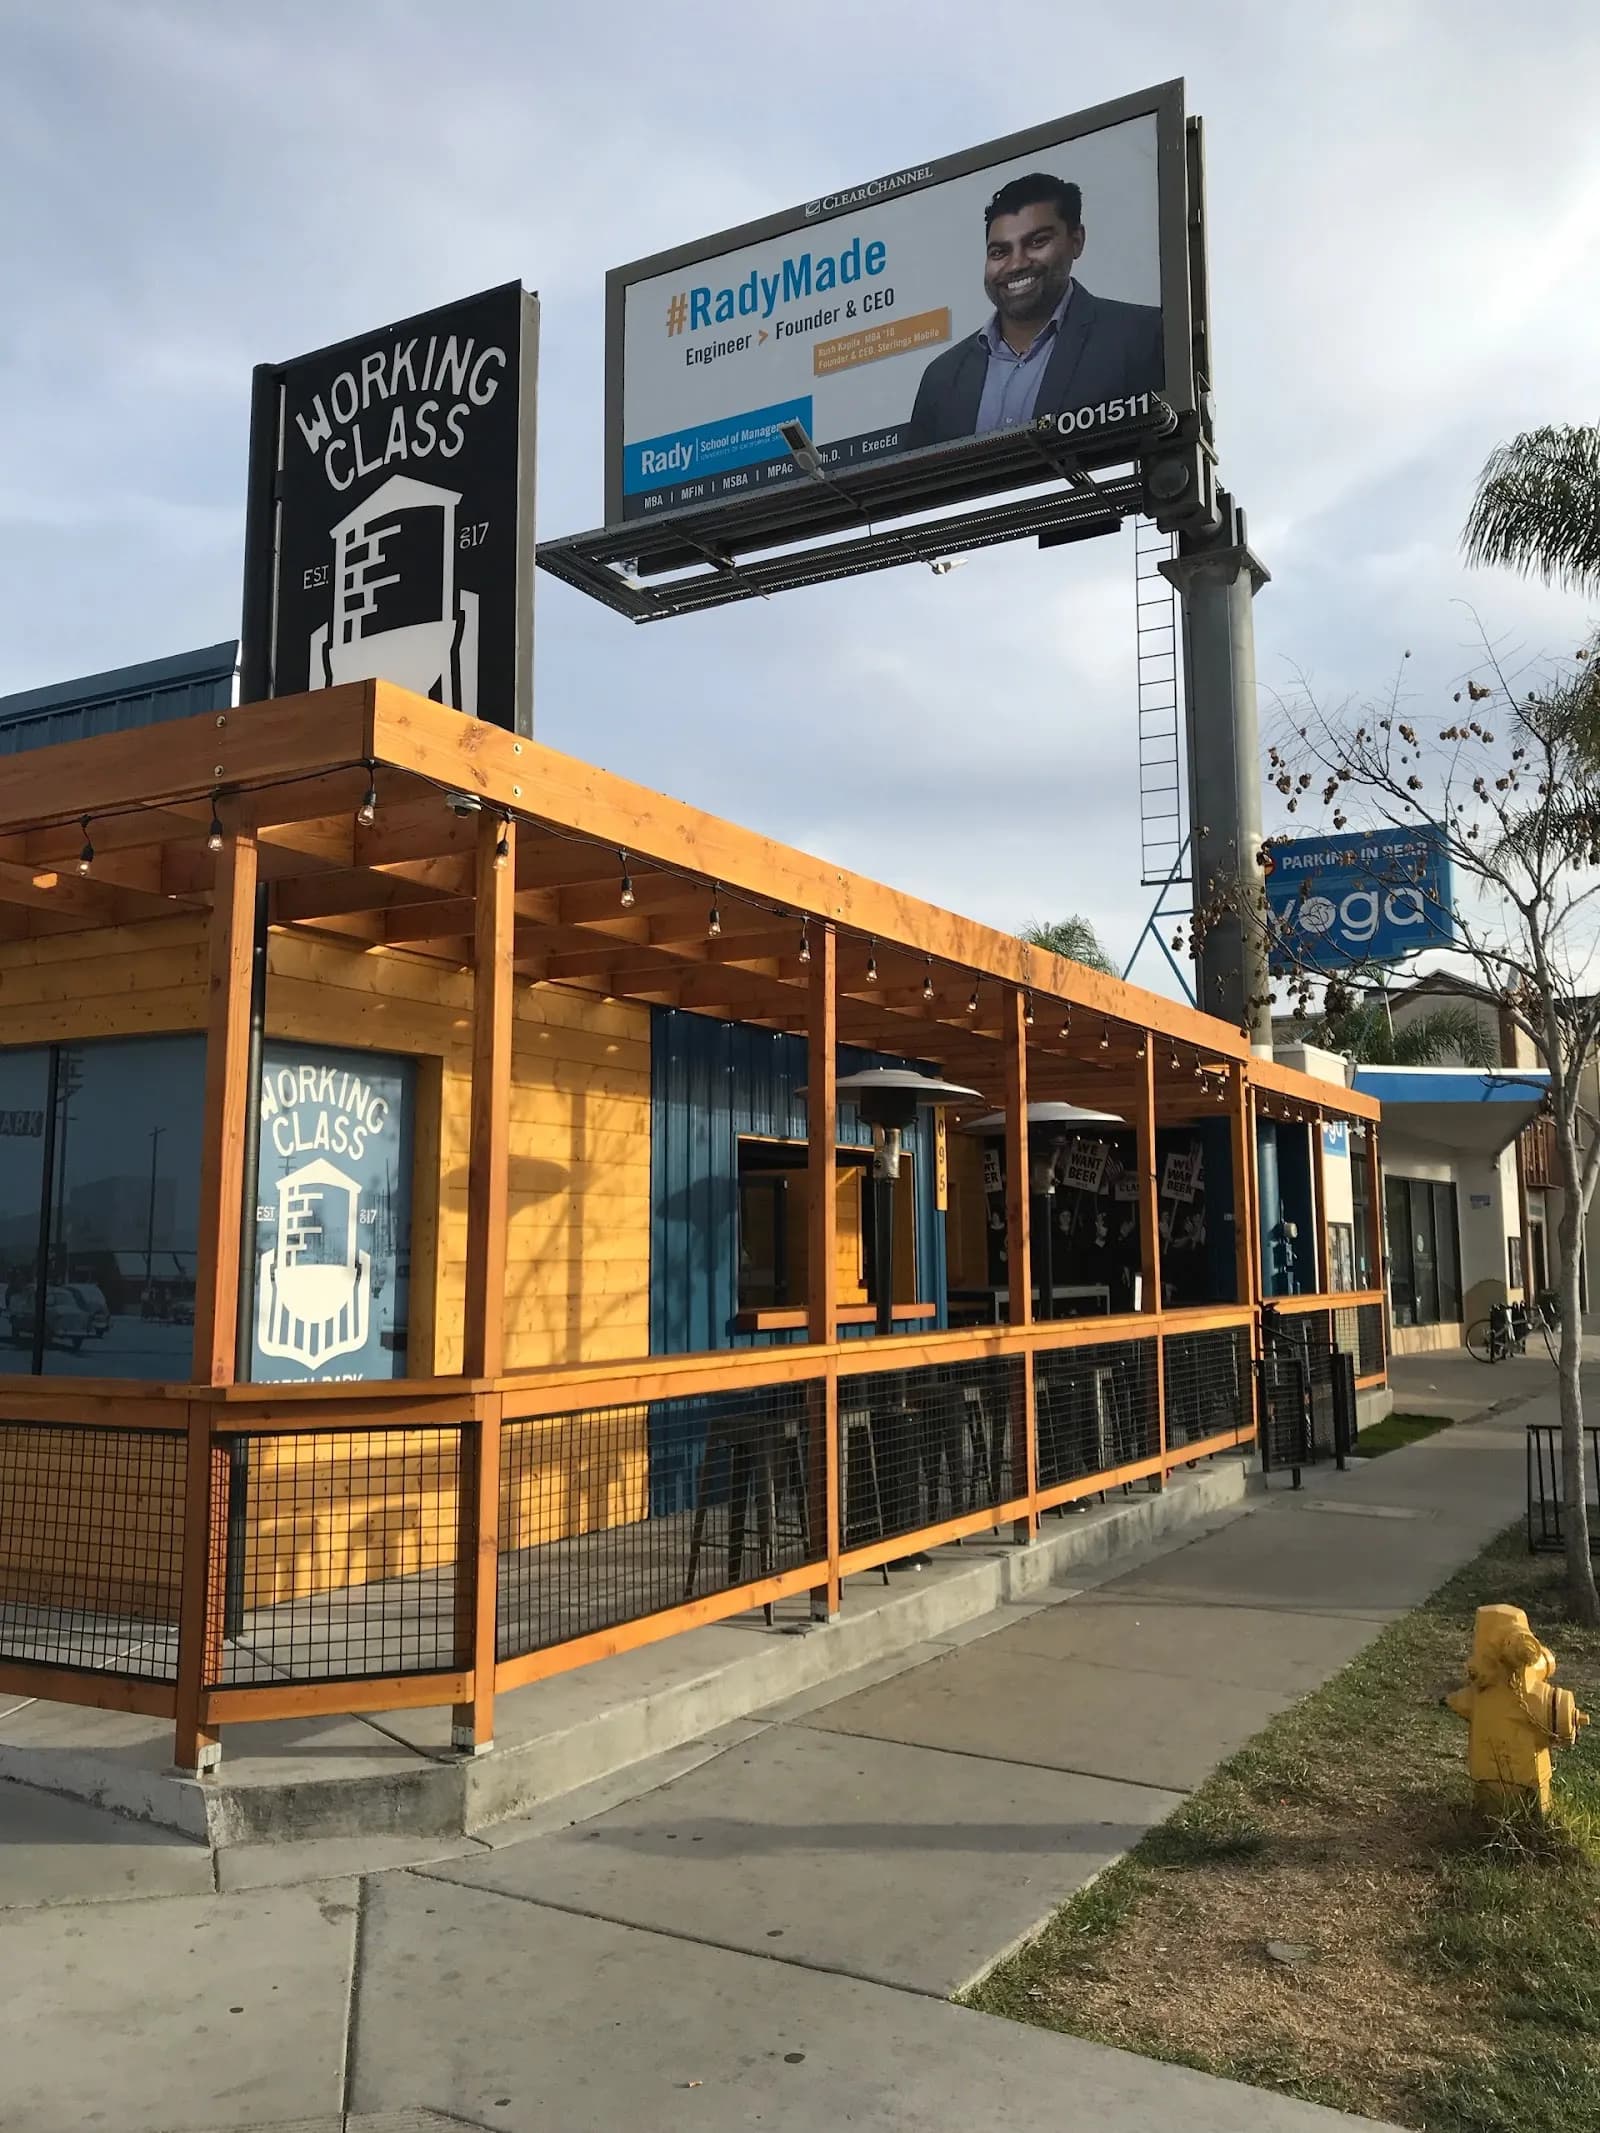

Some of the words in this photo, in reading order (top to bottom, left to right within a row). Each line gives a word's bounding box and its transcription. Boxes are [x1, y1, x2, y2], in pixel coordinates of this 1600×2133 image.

[666, 236, 888, 338] #RadyMade
[686, 334, 752, 366] Engineer
[776, 307, 840, 340] Founder
[845, 299, 857, 319] &
[863, 287, 895, 313] CEO
[818, 353, 849, 369] Founder
[296, 335, 507, 455] WORKING
[1057, 392, 1149, 435] 001511
[325, 400, 471, 492] CLASS
[641, 441, 693, 476] Rady
[700, 434, 730, 453] School
[730, 430, 739, 444] of
[644, 494, 664, 510] MBA
[681, 484, 704, 501] MFIN
[722, 472, 748, 490] MSBA
[767, 462, 794, 479] MPAc
[819, 449, 841, 464] h.D.
[862, 433, 898, 454] ExecEd
[1360, 847, 1379, 860] IN
[1266, 886, 1425, 943] yoga
[272, 1110, 369, 1161] CLASS
[1068, 1166, 1097, 1185] BEER
[1071, 1153, 1103, 1171] WANT
